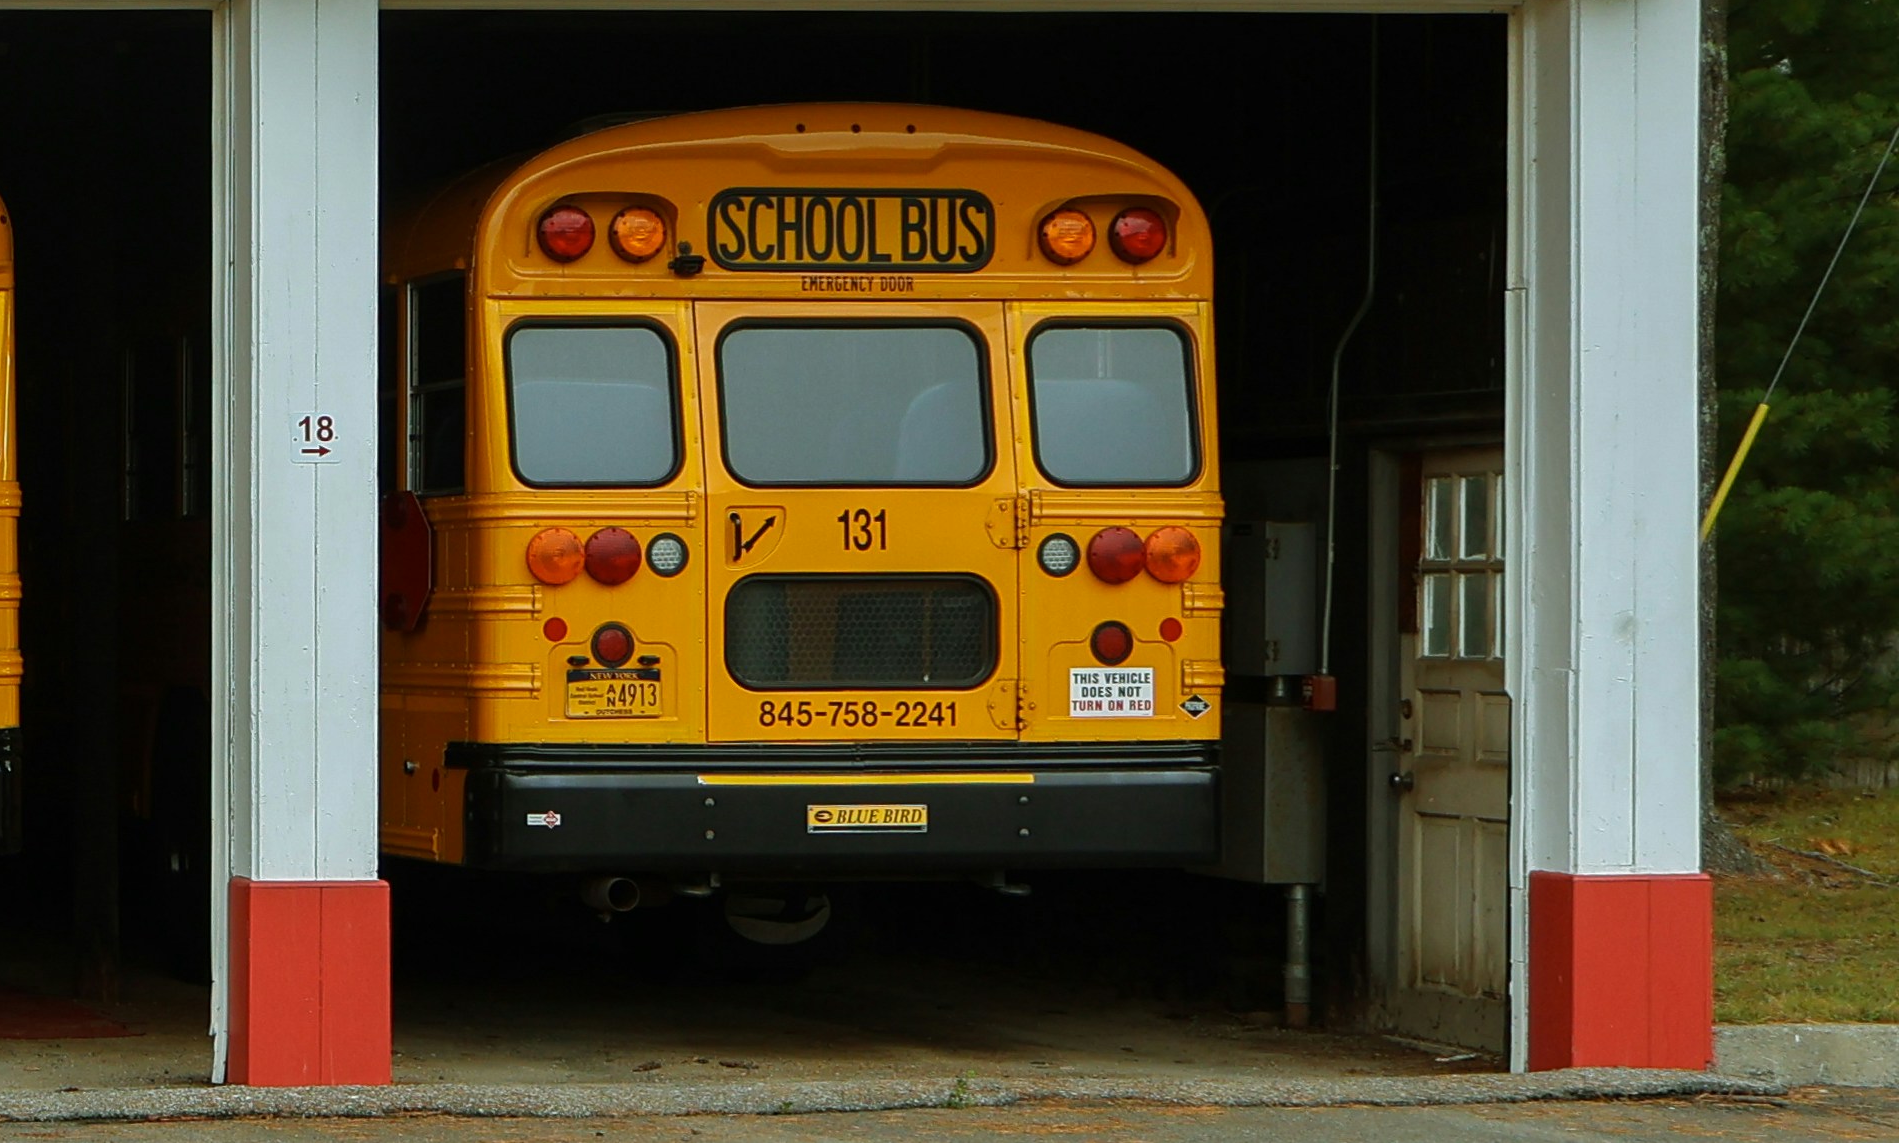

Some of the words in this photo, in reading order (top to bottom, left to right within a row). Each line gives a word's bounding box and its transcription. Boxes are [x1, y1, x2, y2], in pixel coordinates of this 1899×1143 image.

[718, 196, 892, 263] SCHOOL
[901, 197, 986, 263] BUS
[801, 276, 874, 292] EMERGENCY
[880, 276, 914, 292] DOOR
[298, 415, 334, 442] 18
[837, 508, 887, 551] 131
[1072, 673, 1100, 684] THIS
[1104, 672, 1151, 684] VEHICLE
[618, 683, 657, 706] 4913
[1081, 686, 1113, 698] DOES
[1118, 686, 1142, 697] NOT
[758, 700, 957, 727] 845-758-2241
[1071, 700, 1103, 711] TURN
[1108, 700, 1124, 711] ON
[1129, 700, 1151, 711] RED
[836, 809, 879, 824] BLUE
[883, 808, 922, 823] BIRD
